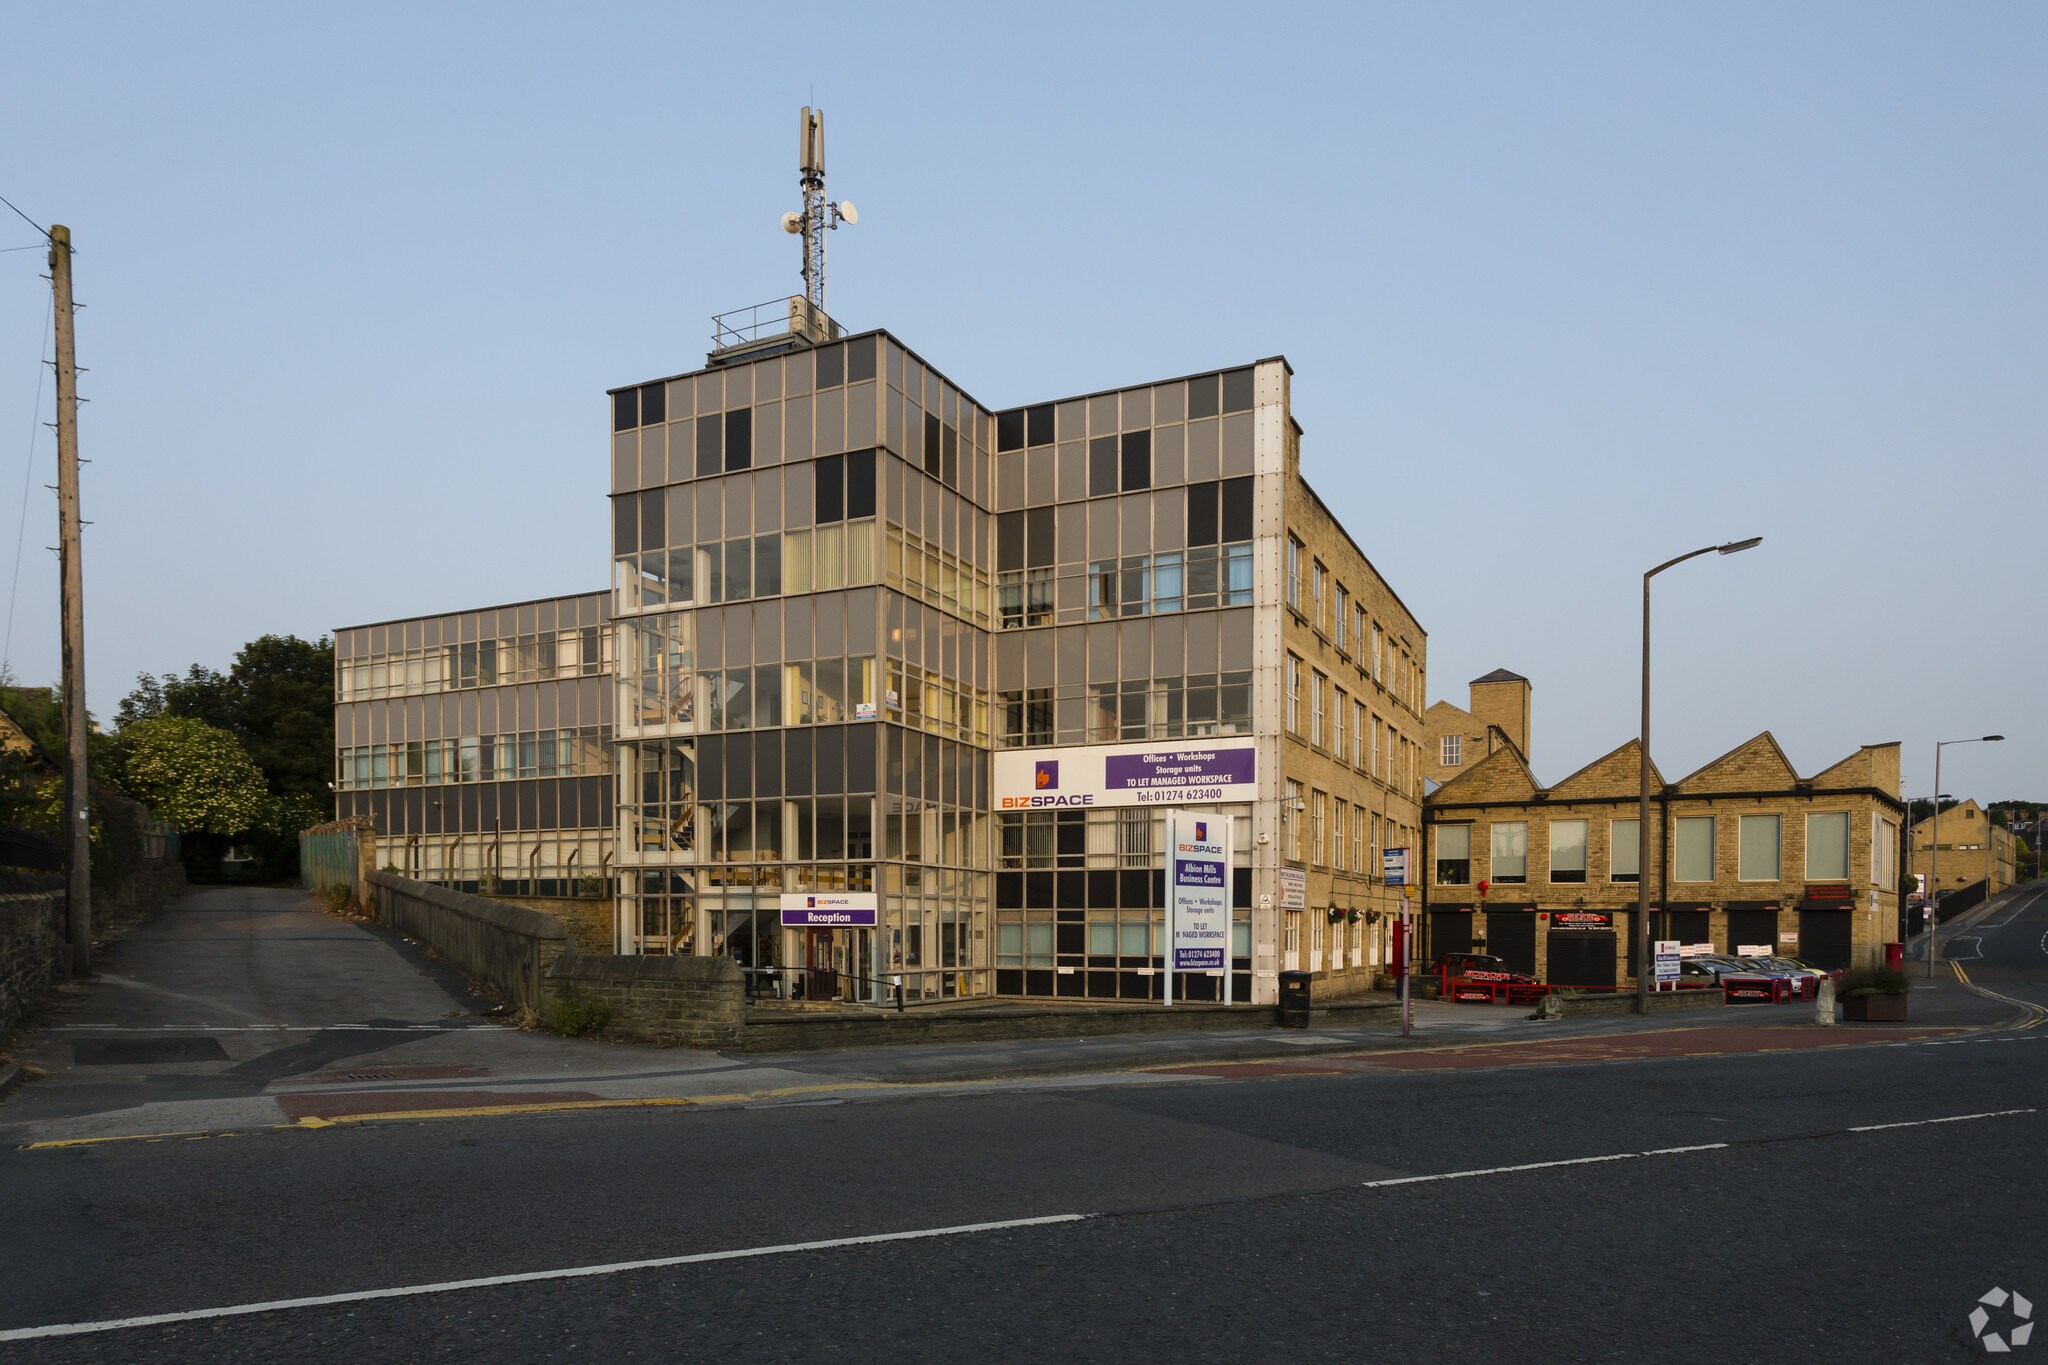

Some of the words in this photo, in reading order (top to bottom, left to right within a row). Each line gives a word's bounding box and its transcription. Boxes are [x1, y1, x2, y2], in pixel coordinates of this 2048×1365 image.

[1143, 754, 1167, 763] Offices
[1177, 752, 1216, 762] Workshops
[1155, 766, 1183, 775] Storage
[1184, 765, 1202, 773] units
[1127, 778, 1136, 787] TO
[1138, 778, 1150, 787] LET
[1150, 776, 1187, 786] MANAGED
[1188, 774, 1232, 784] WORKSPACE
[1186, 788, 1222, 800] 623400
[1002, 794, 1094, 809] BIZSPACE
[1179, 844, 1222, 854] BIZSPACE
[1185, 863, 1202, 873] Albion
[1203, 864, 1216, 874] Mills
[1180, 873, 1203, 883] Business
[1203, 875, 1221, 885] Centre
[1178, 897, 1193, 905] Offices
[1199, 898, 1222, 907] Workshops
[1186, 906, 1203, 915] Storage
[808, 912, 851, 924] Reception
[1175, 931, 1198, 939] MNAGED
[1199, 931, 1225, 939] WORKSPACE
[1203, 950, 1220, 958] 623400
[1180, 959, 1220, 967] www.bizspace.co.uk
